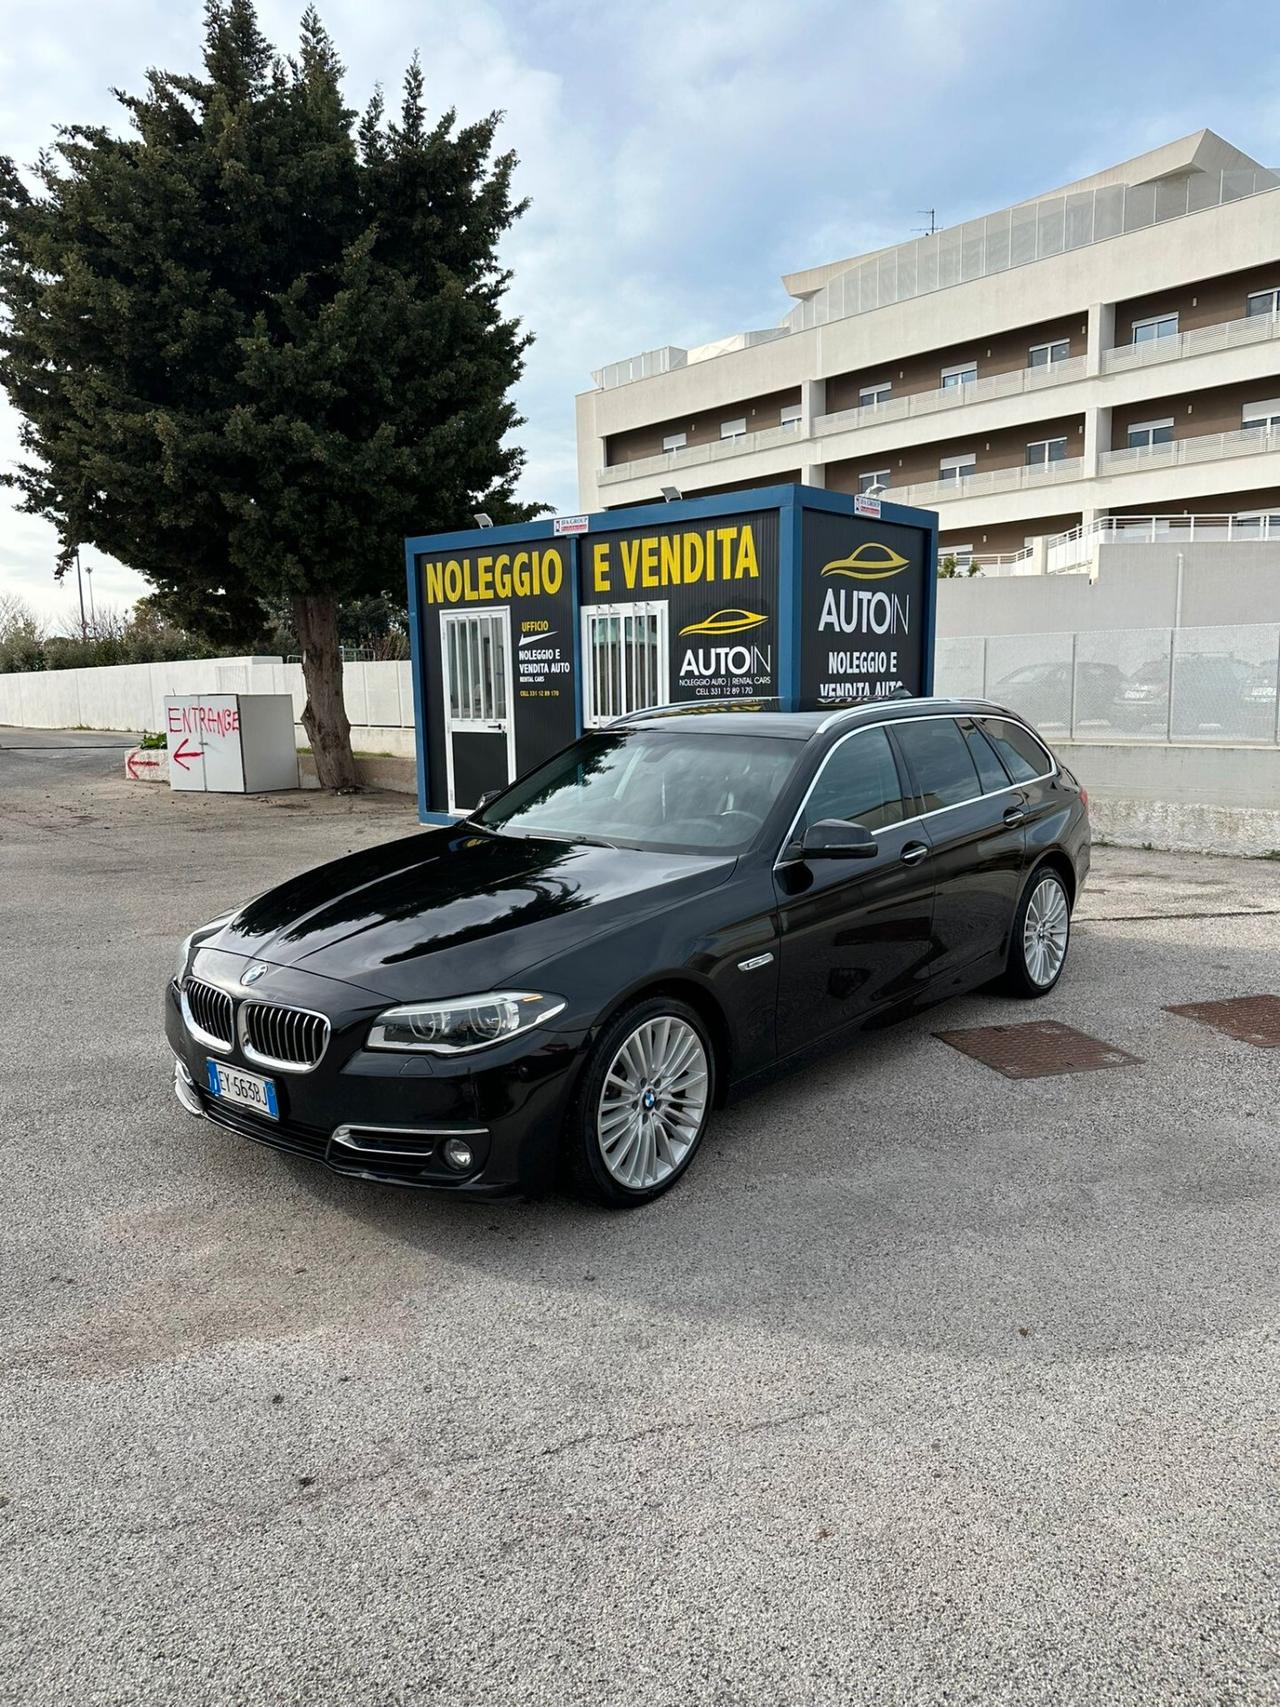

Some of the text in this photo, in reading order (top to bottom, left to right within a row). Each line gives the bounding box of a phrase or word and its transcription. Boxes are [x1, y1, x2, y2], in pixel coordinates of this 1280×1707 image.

[426, 525, 759, 604] NOLEGGIO E VENDITA
[818, 588, 910, 635] AUTOIN
[521, 620, 549, 632] UFFICIO
[518, 649, 561, 660] NOLEGGIO E
[679, 644, 771, 677] AUTOIN
[519, 662, 571, 674] VENDITA AUTO
[828, 651, 898, 674] NOLEGGIO E
[679, 676, 771, 686] NOLEGGIO AUTO RENTAL CARS
[710, 687, 721, 695] 331
[723, 687, 730, 695] 12
[731, 687, 739, 695] 89
[820, 681, 904, 697] VENDITA AUT
